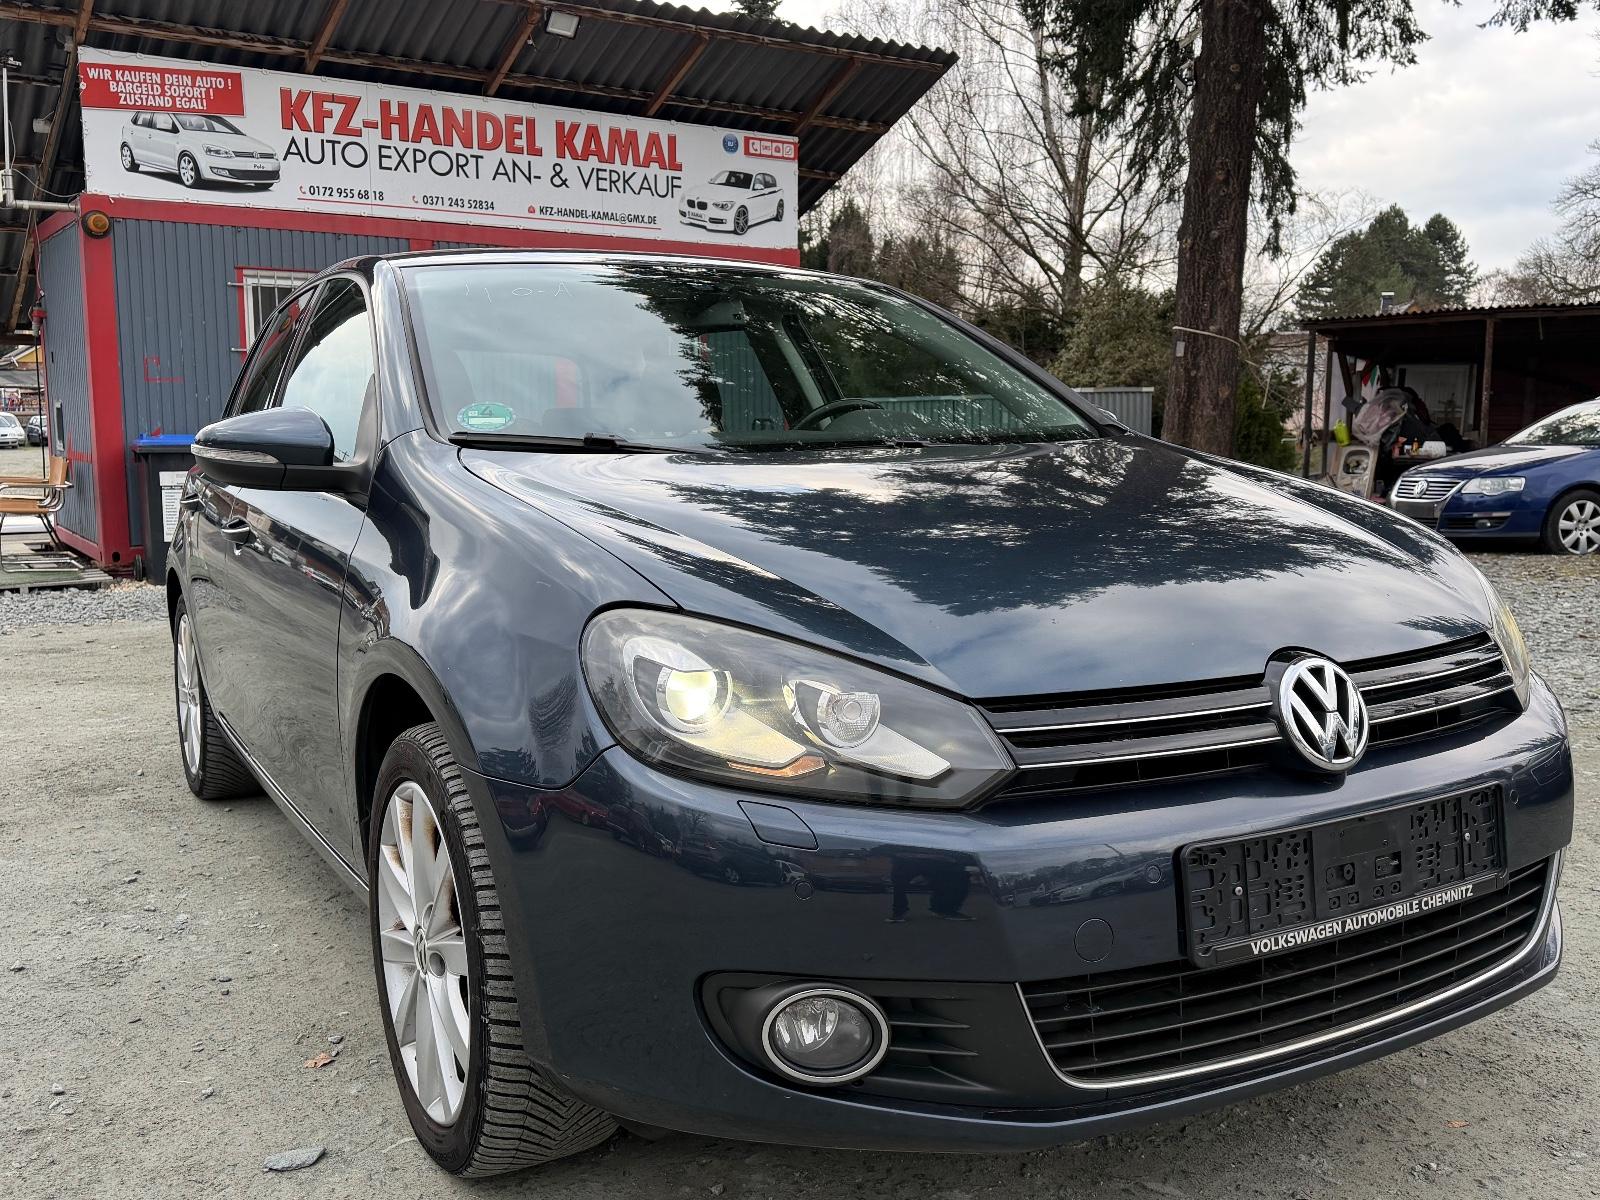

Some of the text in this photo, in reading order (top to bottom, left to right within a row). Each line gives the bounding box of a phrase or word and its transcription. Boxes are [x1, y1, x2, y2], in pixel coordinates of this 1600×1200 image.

[87, 67, 112, 81] WIR
[115, 70, 160, 84] KAUFEN
[165, 73, 192, 87] DEIN
[196, 77, 224, 89] AUTO
[109, 81, 161, 95] BARGELD
[165, 85, 206, 98] SOFORT
[119, 93, 207, 110] ZUSTAND EGAL!
[280, 87, 682, 171] KFZ-HANDEL KAMAL
[282, 136, 682, 198] AUTO EXPORT AN- & VERKAUF
[308, 185, 384, 201] 0172 955 68 18
[422, 195, 495, 211] 0371 243 52834
[539, 205, 657, 225] KFZ-HANDEL-KAMAL@GMX.DE
[1281, 657, 1369, 771] VW
[1251, 884, 1474, 955] VOLKSWAGEN AUTOMOBILE CHEMNITZ
